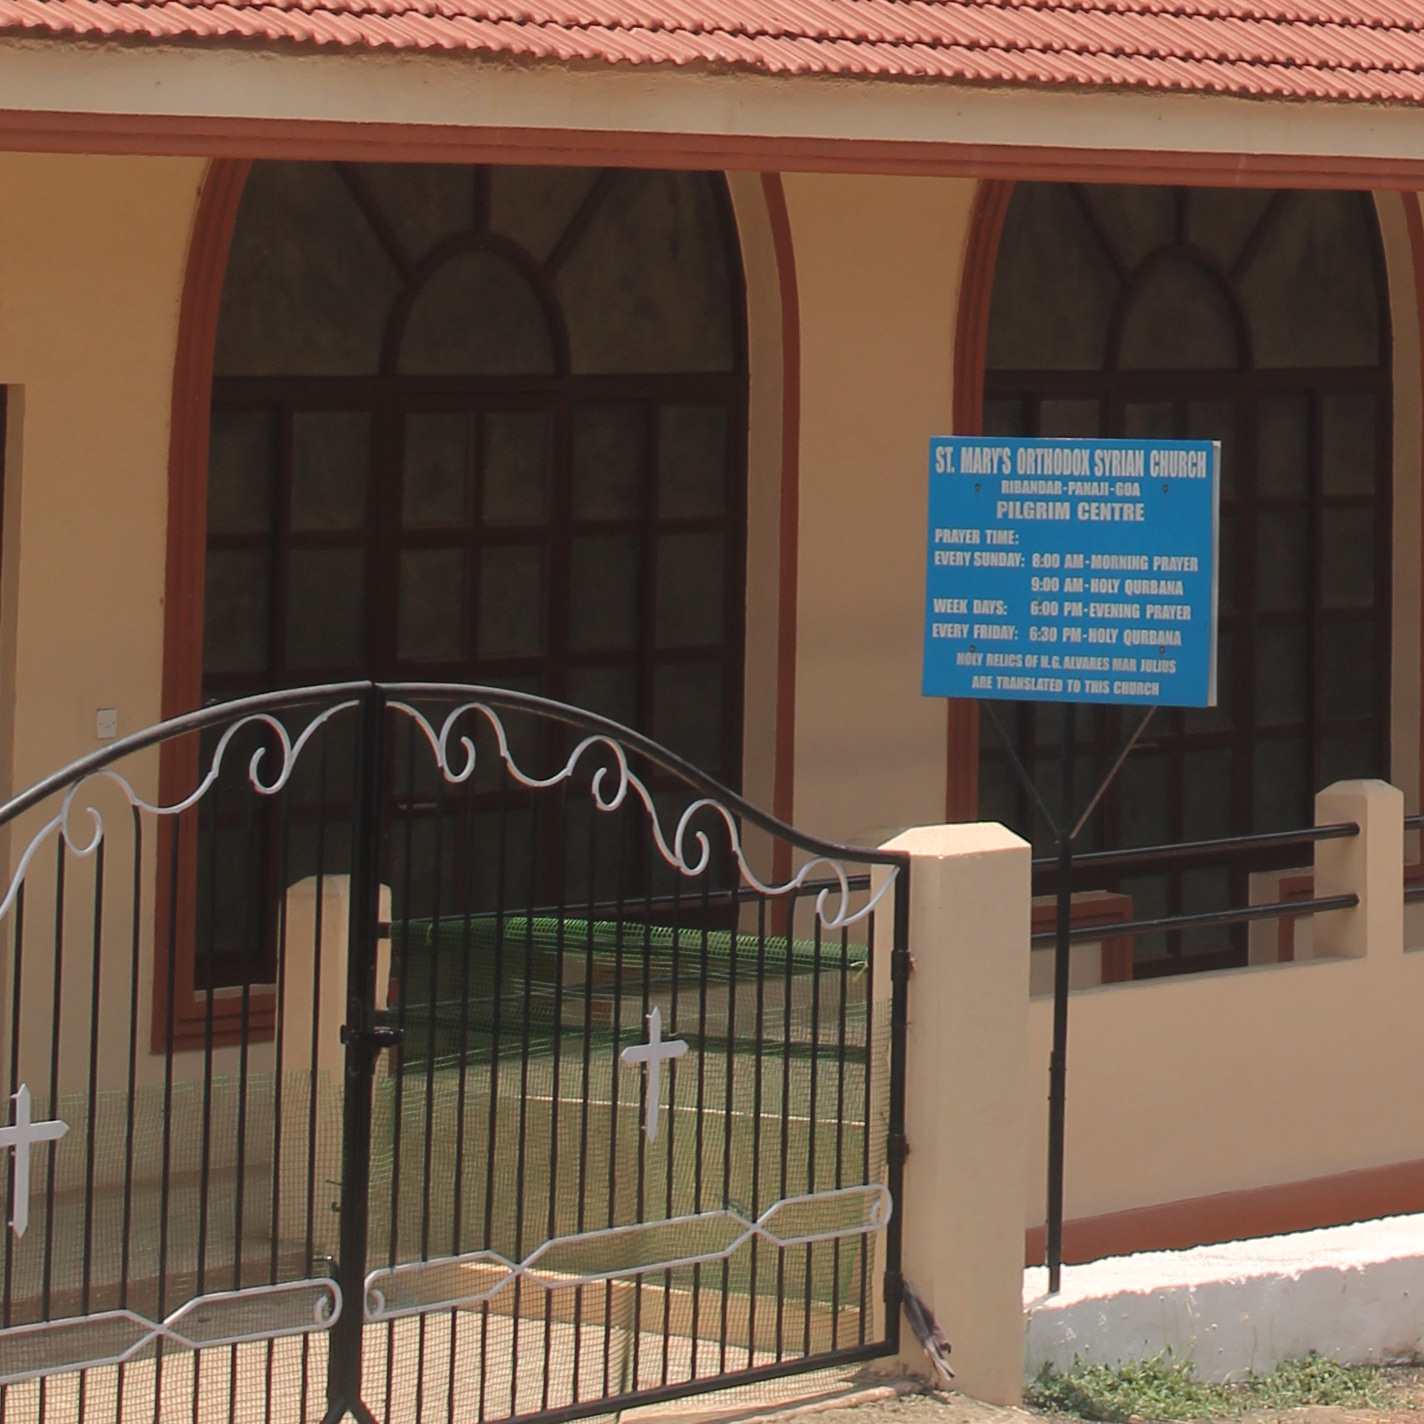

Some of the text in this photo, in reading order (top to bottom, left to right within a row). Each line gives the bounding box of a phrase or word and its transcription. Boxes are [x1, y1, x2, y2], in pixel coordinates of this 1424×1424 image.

[935, 446, 1207, 478] ST. MARY'S ORTHODOX SYRIAN CHURCH
[997, 501, 1145, 521] PILGRIM CENTRE
[935, 529, 1019, 545] PRAYER TIME:
[934, 551, 972, 566] EVERY
[973, 551, 1025, 567] SUNDAY:
[1032, 553, 1060, 568] 8:00
[1153, 556, 1198, 572] PRAYER
[1031, 577, 1059, 592] 9:00
[1125, 579, 1183, 595] QURBANA
[933, 598, 968, 614] WEEK
[973, 599, 1007, 615] DAYS:
[1030, 601, 1058, 616] 6:00
[1146, 604, 1191, 620] PRAYER
[932, 623, 969, 638] EVERY
[973, 624, 1019, 640] FRIDAY:
[1029, 626, 1057, 642] 6:30
[1123, 629, 1181, 646] QURBANA
[956, 652, 983, 666] HOLY
[986, 653, 1023, 667] RELICS
[1025, 654, 1038, 667] OF
[1063, 656, 1109, 670] ALVARES
[1112, 658, 1136, 672] MAR
[1140, 658, 1176, 673] JULIUS
[972, 675, 1159, 696] ARE TRANSLATED TO THIS CHURCH
